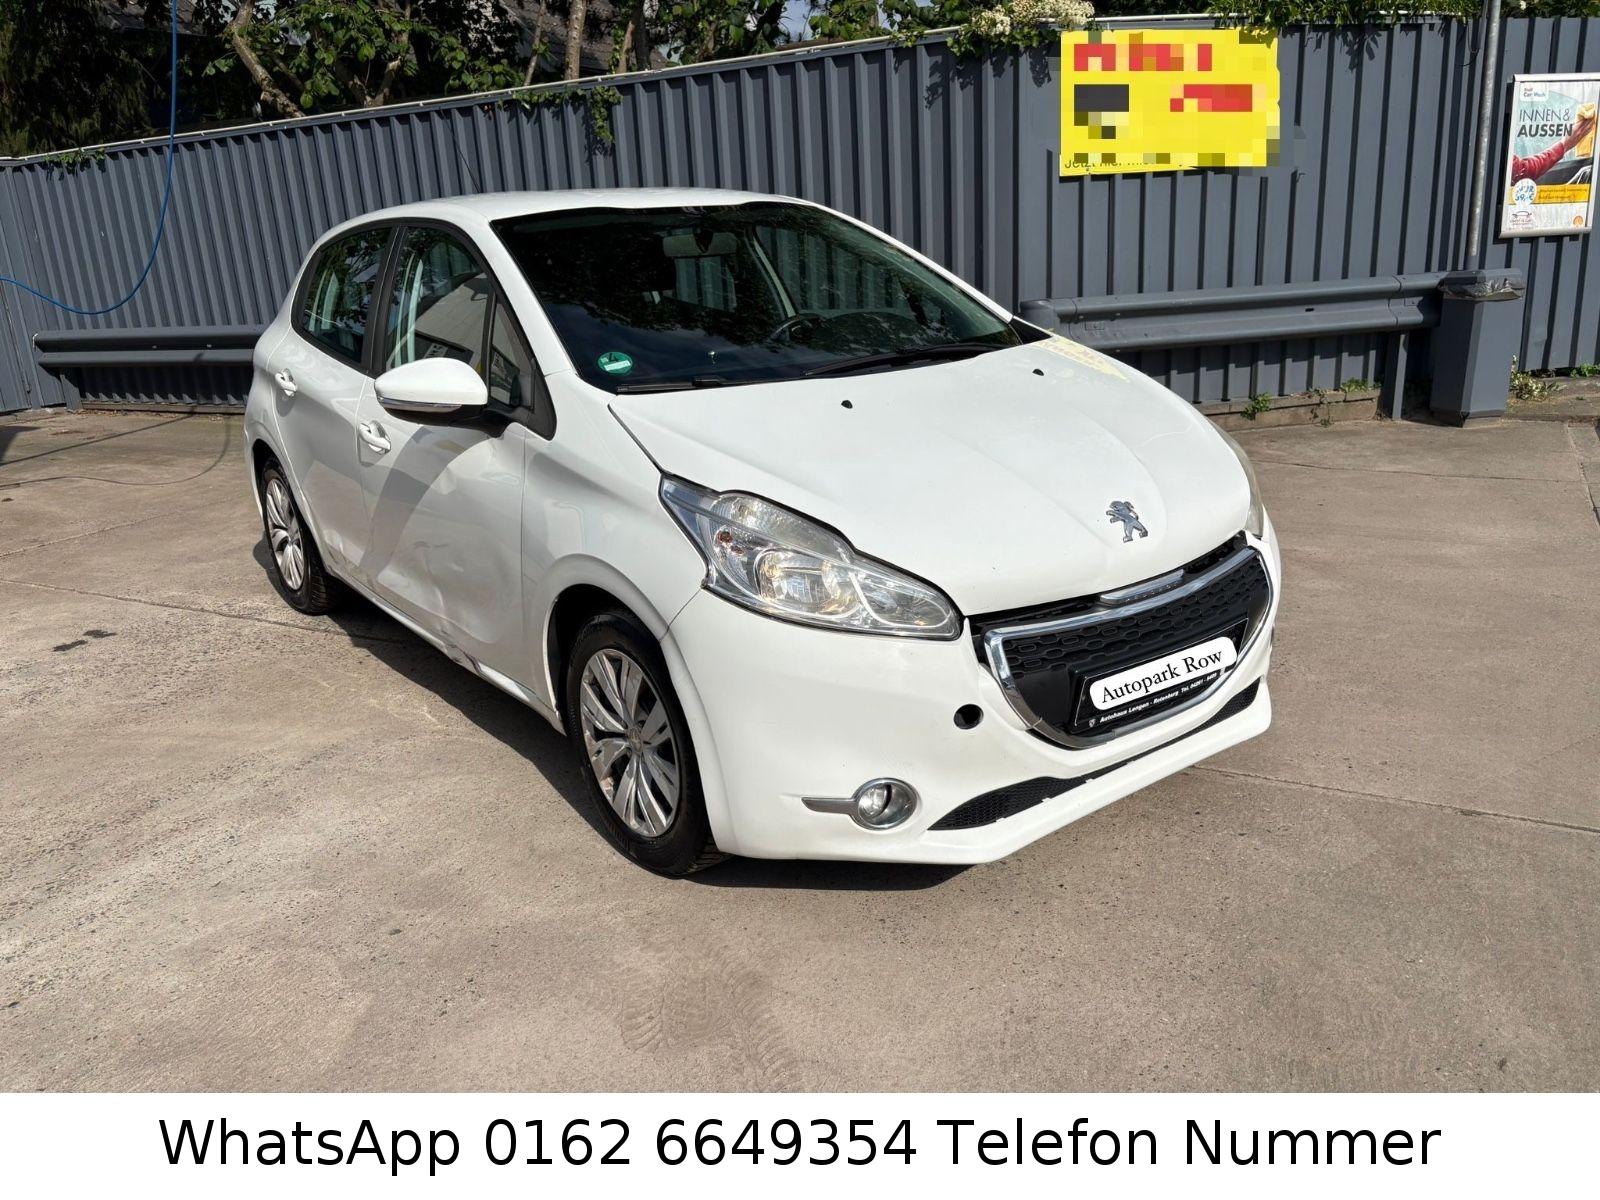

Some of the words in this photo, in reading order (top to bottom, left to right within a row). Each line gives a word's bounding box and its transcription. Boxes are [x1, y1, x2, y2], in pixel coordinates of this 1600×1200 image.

[1519, 108, 1562, 122] INNEN
[1562, 108, 1571, 122] &
[1517, 123, 1573, 137] AUSSEN
